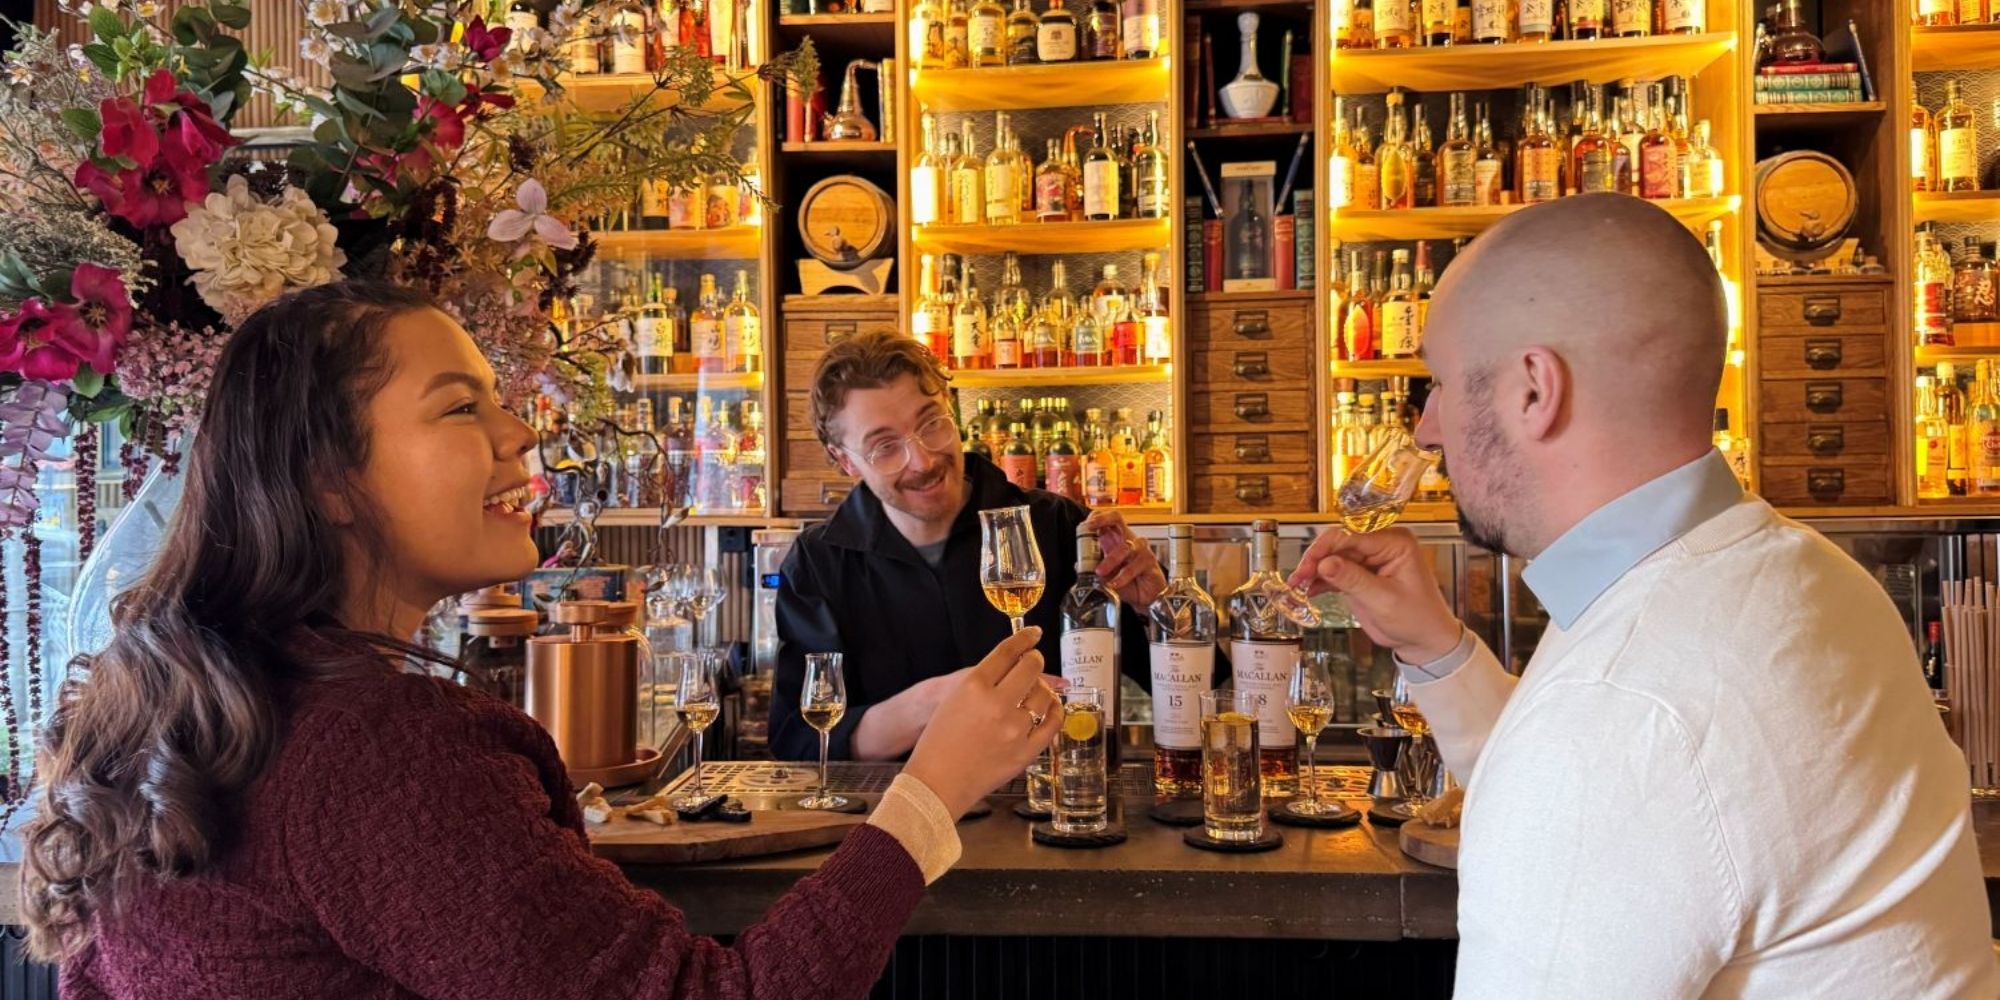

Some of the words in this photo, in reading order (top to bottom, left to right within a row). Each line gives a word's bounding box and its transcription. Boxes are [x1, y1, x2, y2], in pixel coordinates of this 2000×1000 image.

[1153, 670, 1202, 682] MACALLAN
[1236, 669, 1288, 681] MACALLAN
[1072, 677, 1085, 688] 12
[1168, 695, 1183, 707] 15
